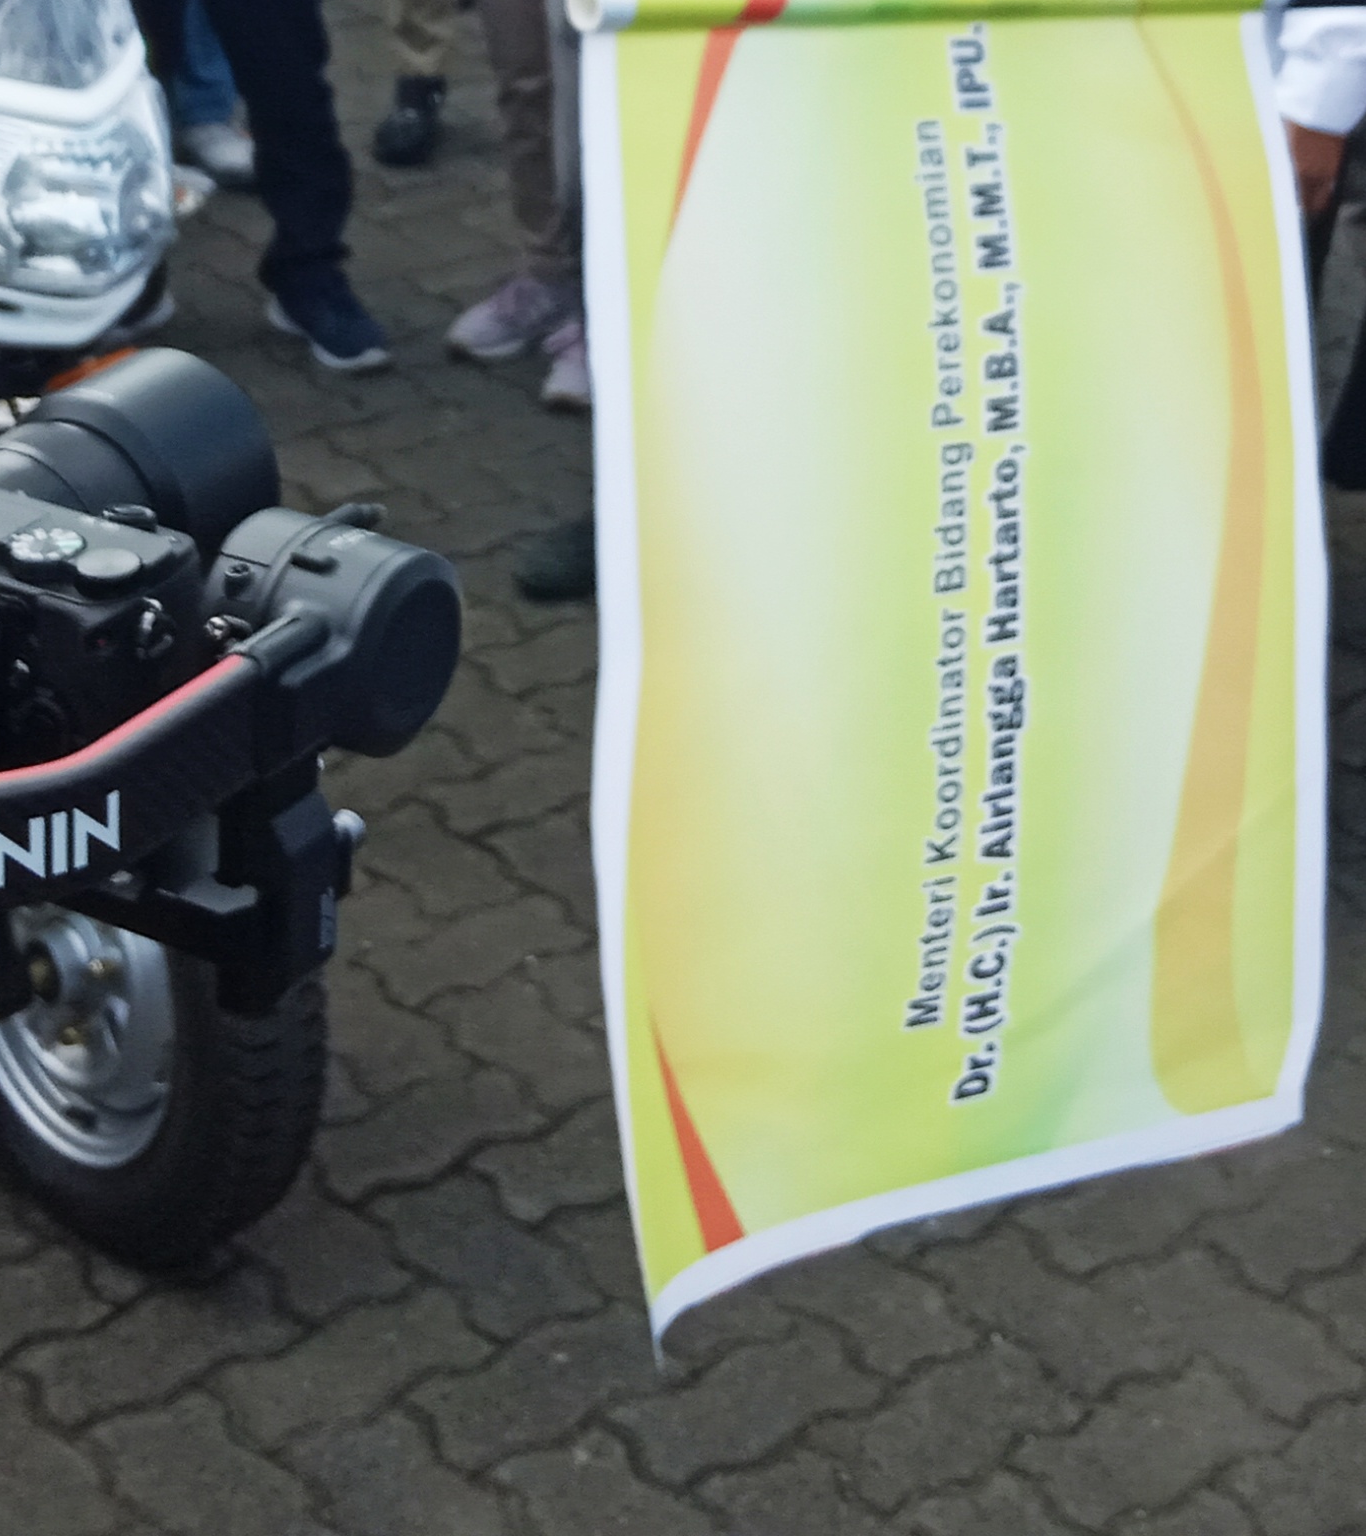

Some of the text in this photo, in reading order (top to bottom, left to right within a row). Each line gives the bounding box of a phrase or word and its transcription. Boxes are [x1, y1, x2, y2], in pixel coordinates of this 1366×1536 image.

[950, 21, 992, 109] IPU.
[965, 121, 1011, 269] M.M.T.,
[982, 281, 1021, 433] M.B.A.,
[905, 118, 973, 1027] Menteri Koordinator Bidang Perekonomian
[985, 443, 1025, 642] Hartarto,
[980, 653, 1025, 858] Airlangga
[975, 870, 1013, 917] Ir.
